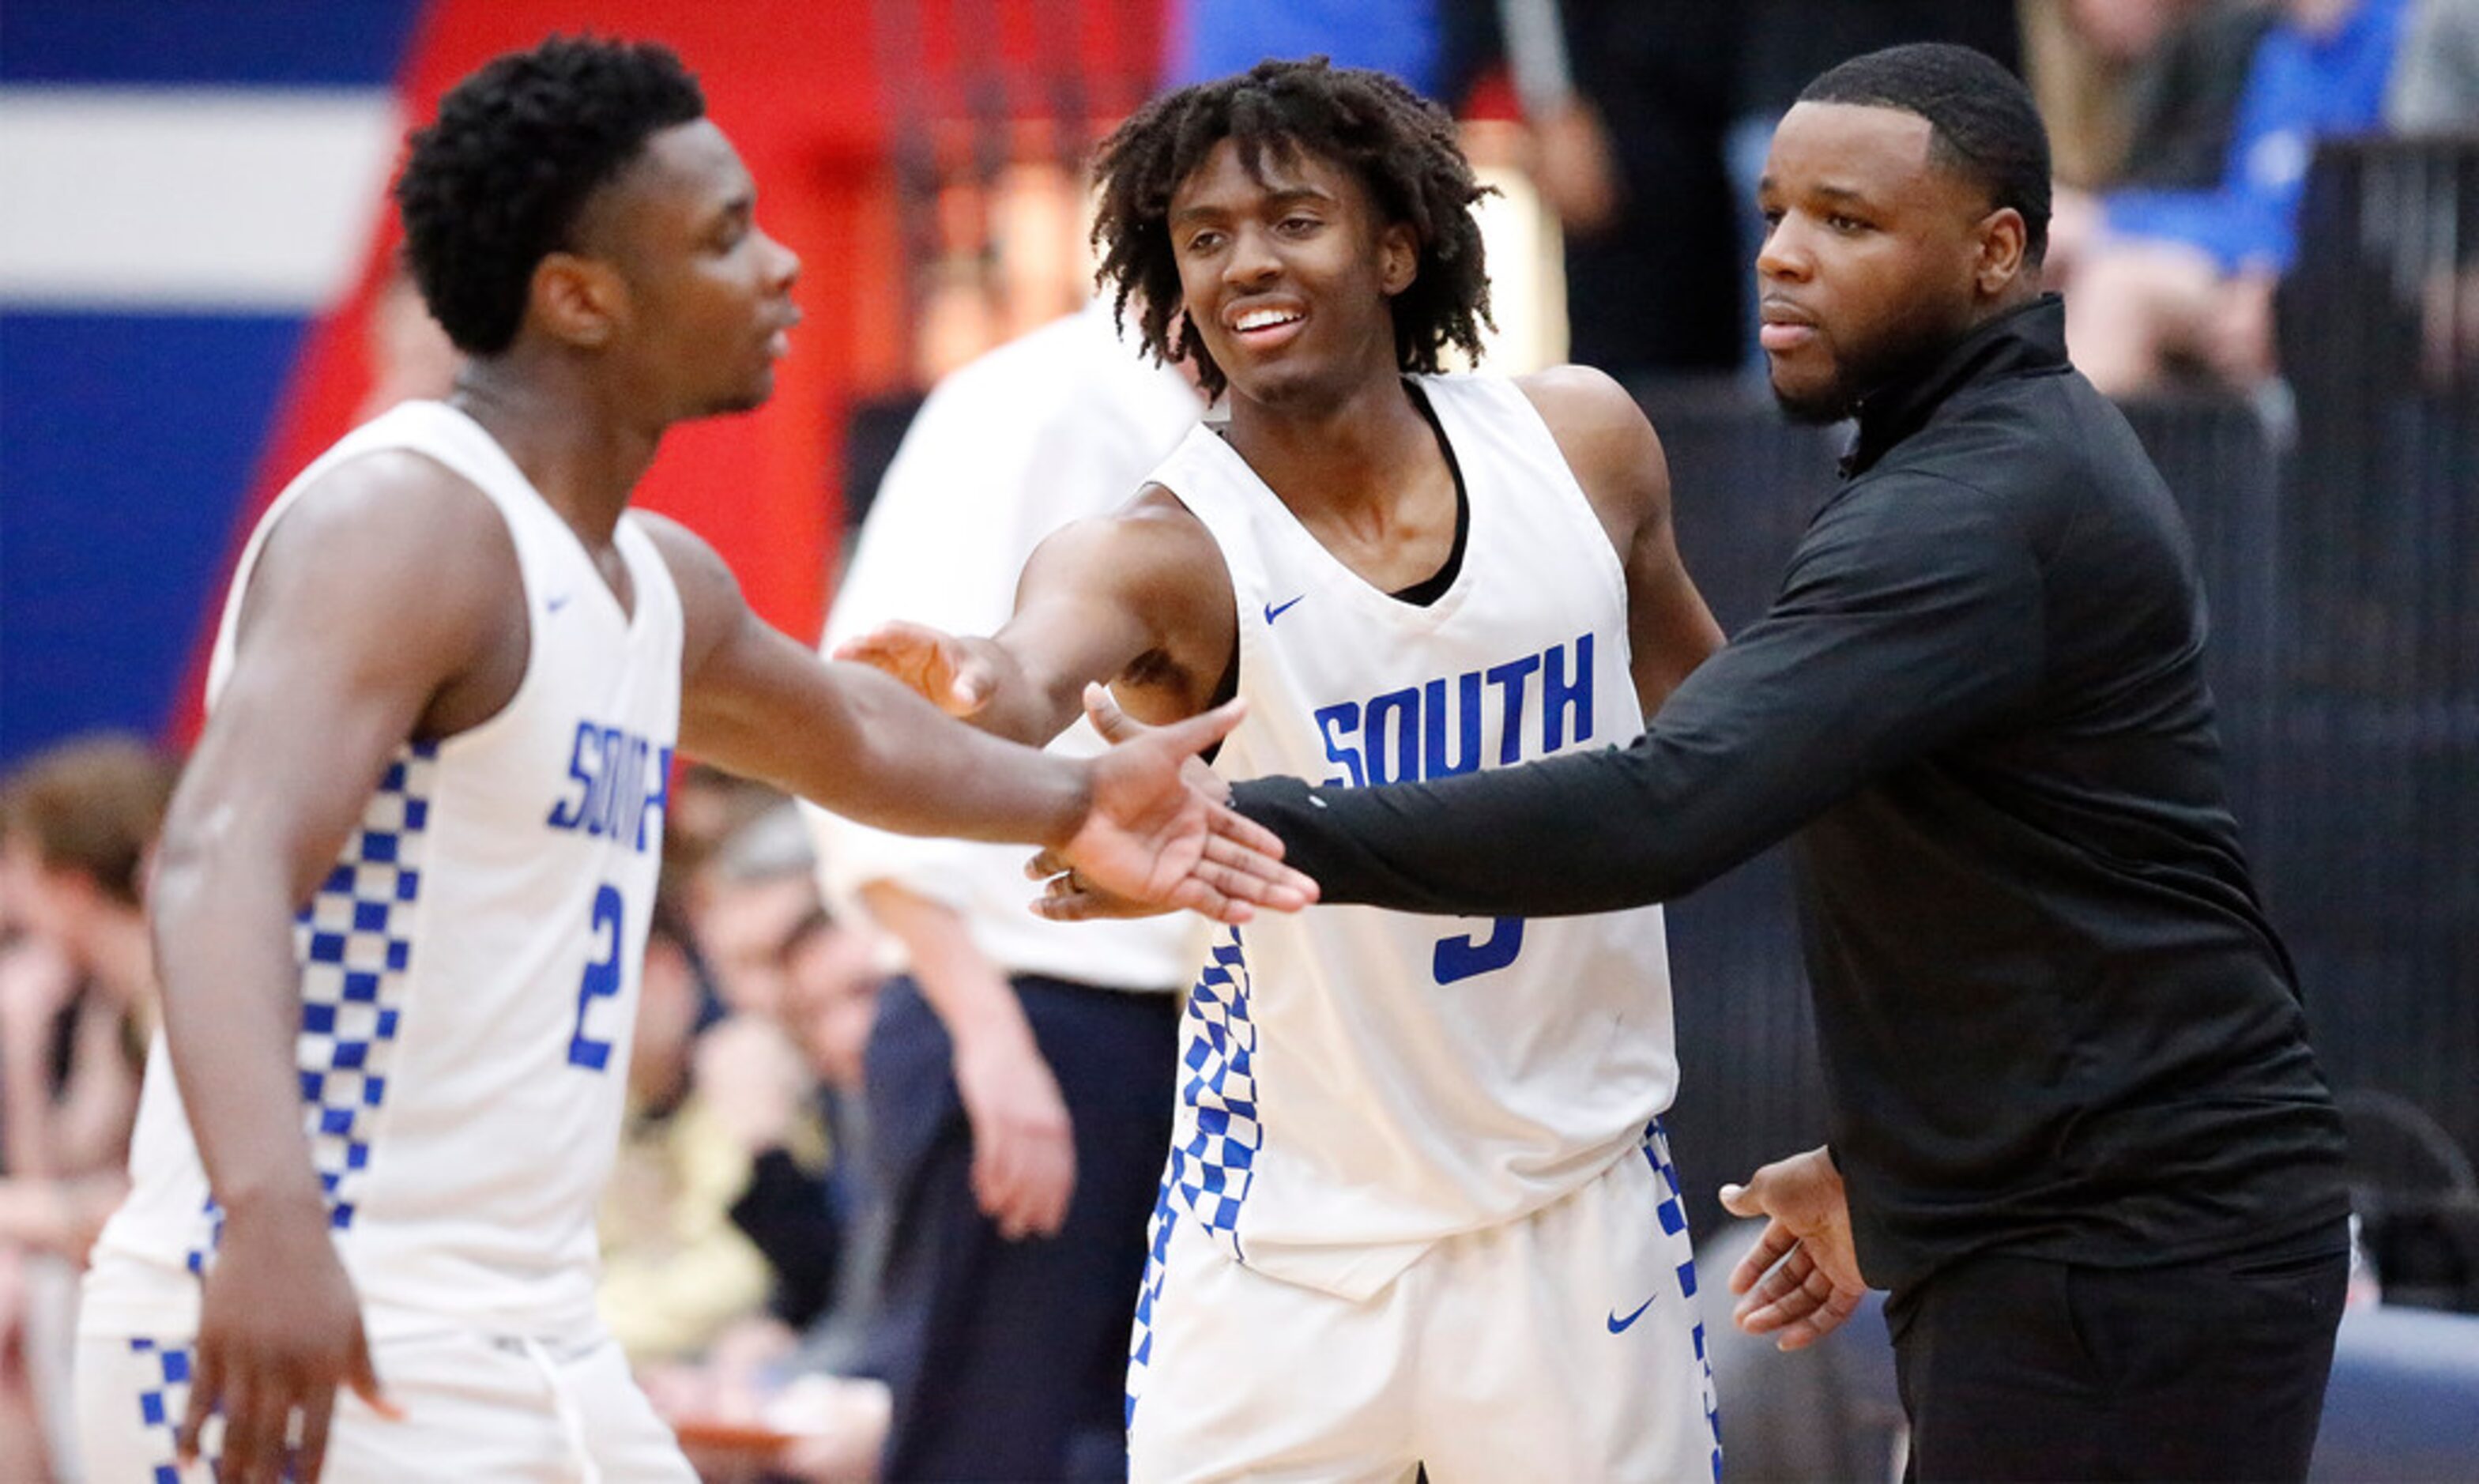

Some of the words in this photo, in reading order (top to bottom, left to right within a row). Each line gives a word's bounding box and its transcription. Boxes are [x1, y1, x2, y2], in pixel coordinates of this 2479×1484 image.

[547, 720, 675, 853] SOH
[1314, 632, 1594, 787] SOUTH
[567, 883, 624, 1071] 2
